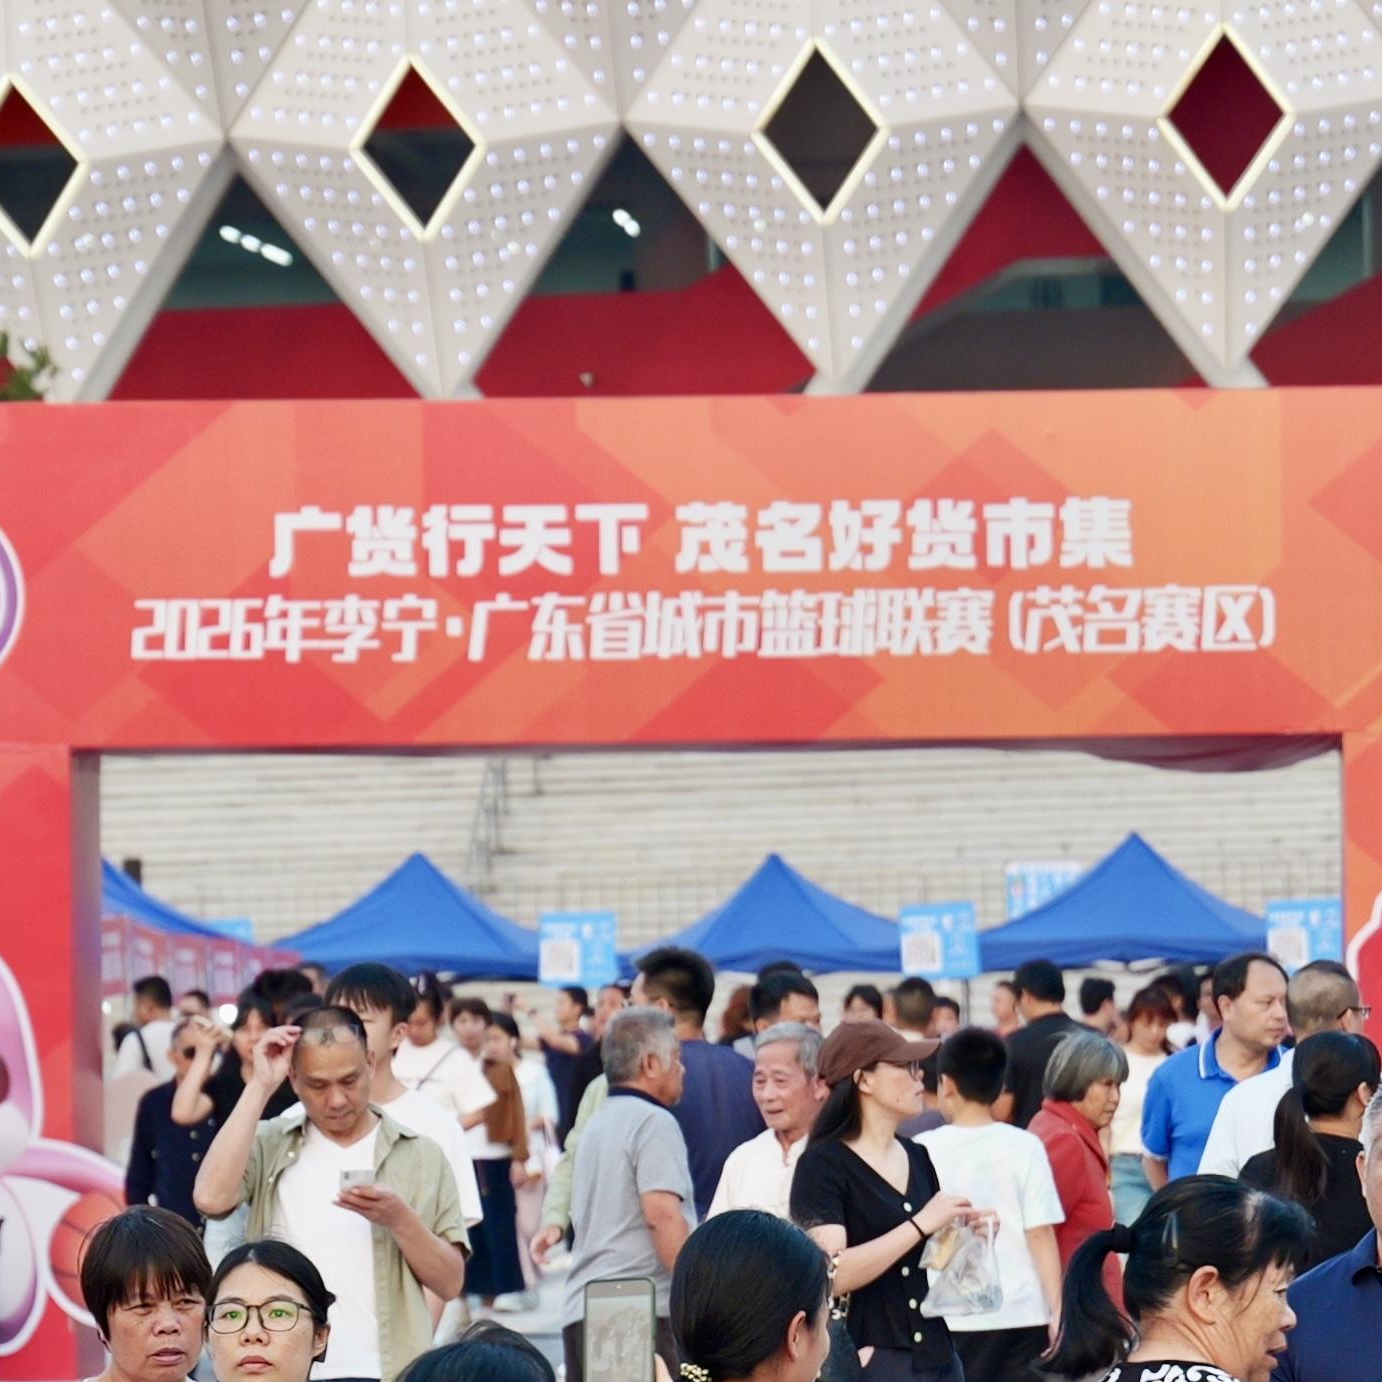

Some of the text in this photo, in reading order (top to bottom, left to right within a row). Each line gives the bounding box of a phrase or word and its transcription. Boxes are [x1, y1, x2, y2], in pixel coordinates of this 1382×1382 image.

[268, 496, 1134, 578] 广货行天下 茂名好货市集
